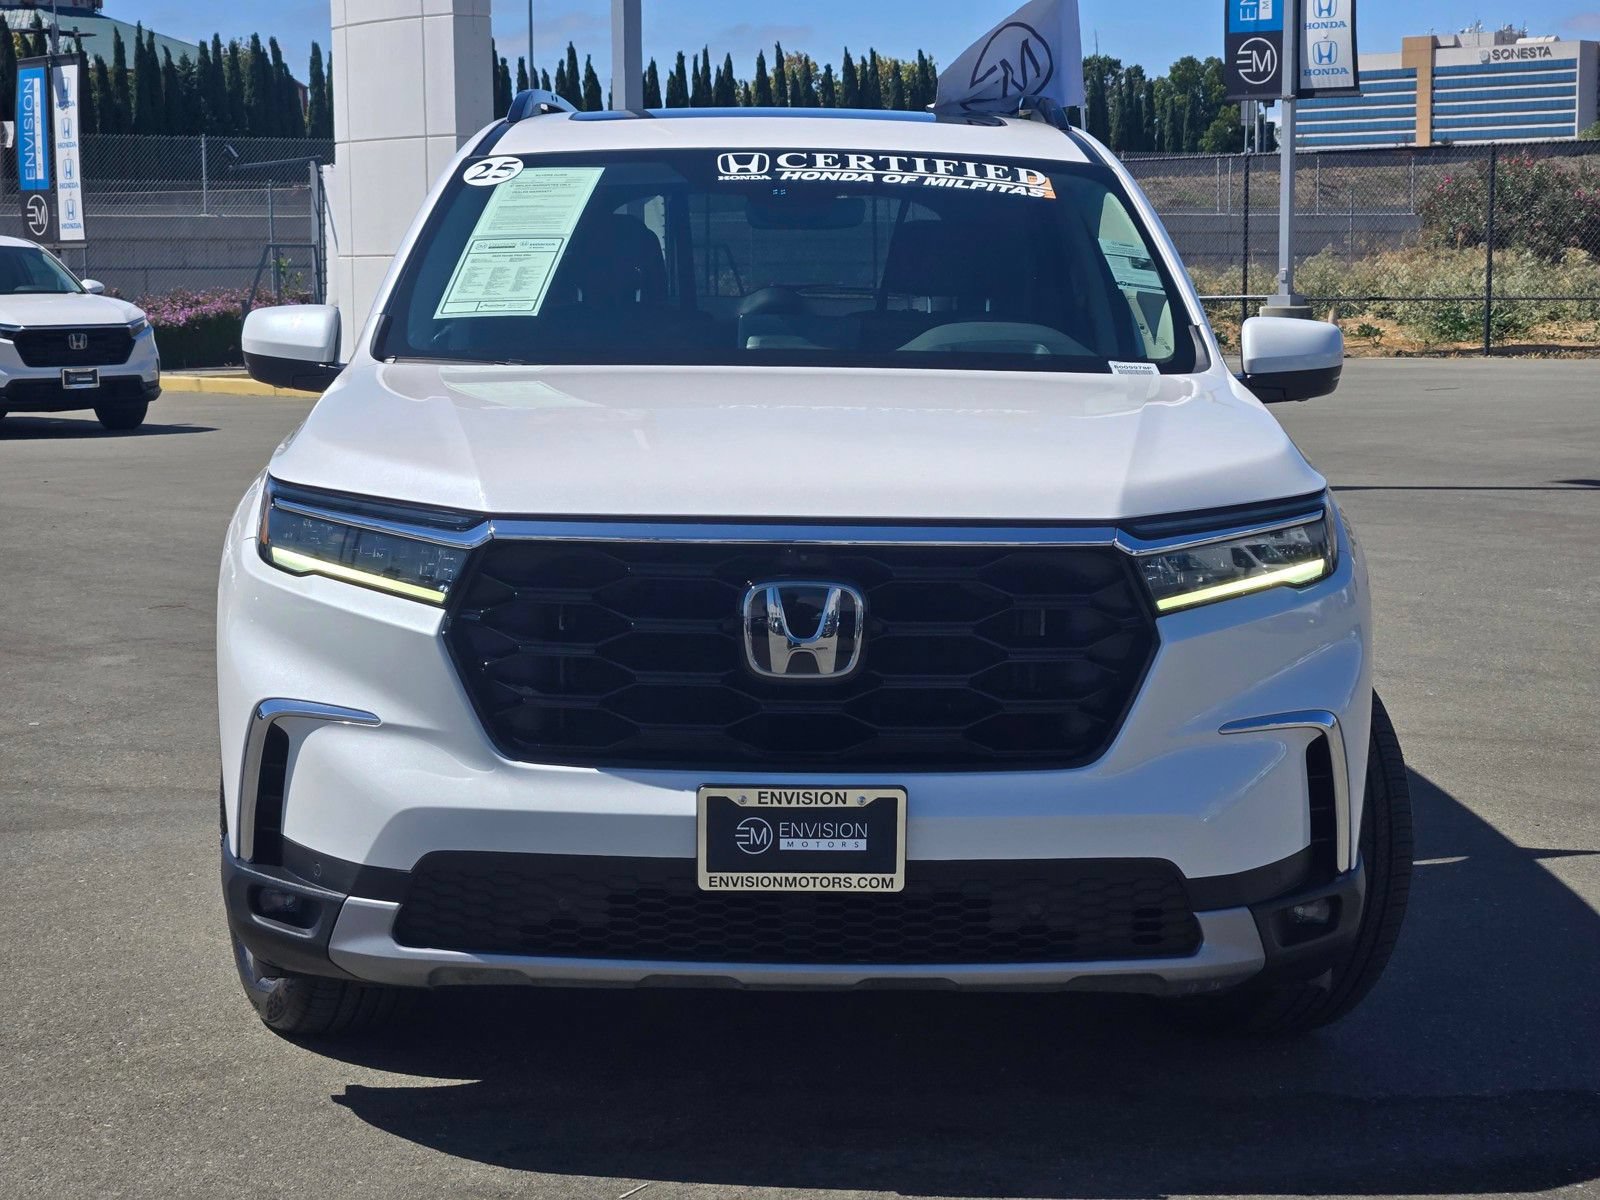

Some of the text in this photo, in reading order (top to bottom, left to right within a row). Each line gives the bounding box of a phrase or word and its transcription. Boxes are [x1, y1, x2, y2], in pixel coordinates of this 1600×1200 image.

[1303, 20, 1348, 31] HONDA
[1491, 46, 1553, 61] SONESTA
[1303, 67, 1350, 77] HONDA
[23, 78, 36, 181] ENVISION
[57, 141, 77, 149] HONDA
[467, 161, 520, 181] 25
[776, 152, 1047, 185] CERTIFIED
[59, 182, 79, 190] HONDA
[780, 171, 875, 183] HONDA
[882, 174, 918, 184] OF
[923, 176, 1046, 199] MILPITAS
[61, 222, 82, 230] HONDA
[757, 791, 848, 806] ENVISION
[779, 822, 868, 838] ENVISION
[786, 841, 860, 849] MOTORS
[708, 876, 894, 890] ENVISIONMOTORS.COM
